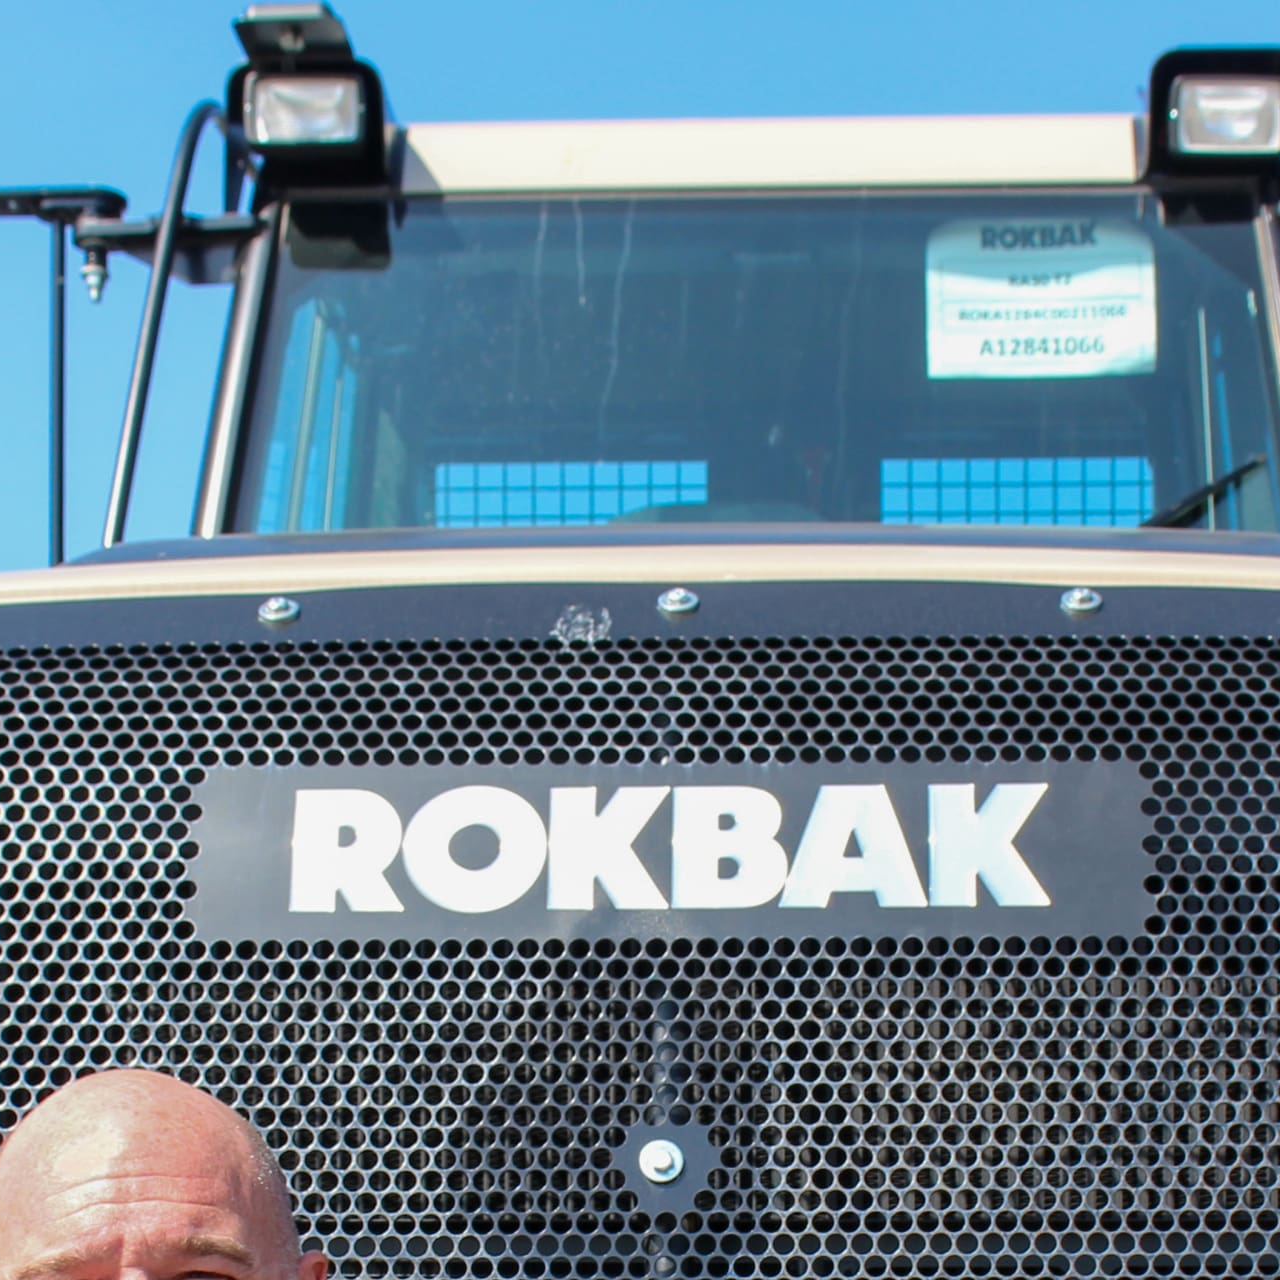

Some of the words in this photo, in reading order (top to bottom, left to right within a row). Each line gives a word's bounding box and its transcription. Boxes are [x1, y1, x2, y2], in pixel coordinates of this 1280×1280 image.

[980, 222, 1097, 249] ROKBAK
[979, 336, 1105, 356] A12841066
[288, 783, 1051, 913] ROKBAK
